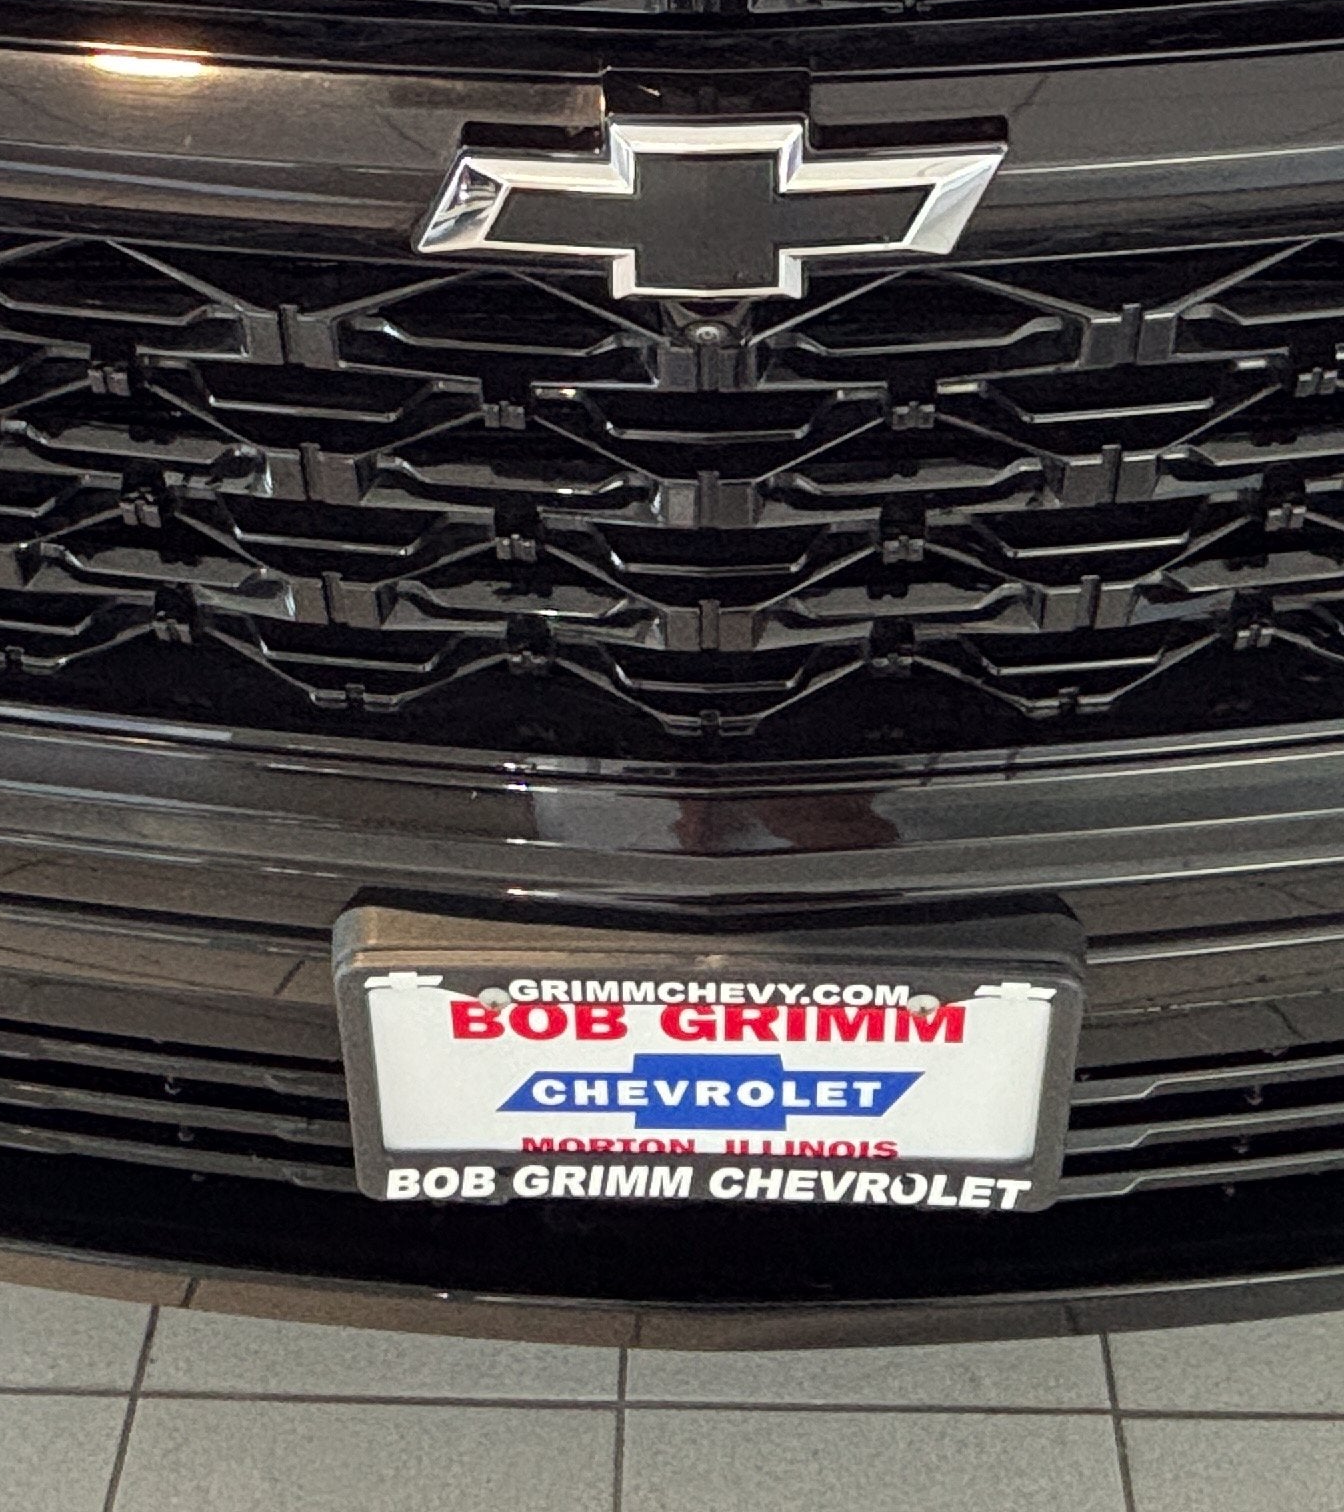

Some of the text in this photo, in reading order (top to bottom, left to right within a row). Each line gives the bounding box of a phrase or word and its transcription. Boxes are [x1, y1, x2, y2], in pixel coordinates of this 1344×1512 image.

[508, 978, 910, 1007] GRIMMCHEVY.COM
[450, 1000, 967, 1044] BOB GRIMM
[531, 1078, 883, 1108] CHEVROLET
[522, 1137, 900, 1160] MORTON ILLINOIS
[386, 1164, 1032, 1210] BOB GRIMM CHEVROLET
